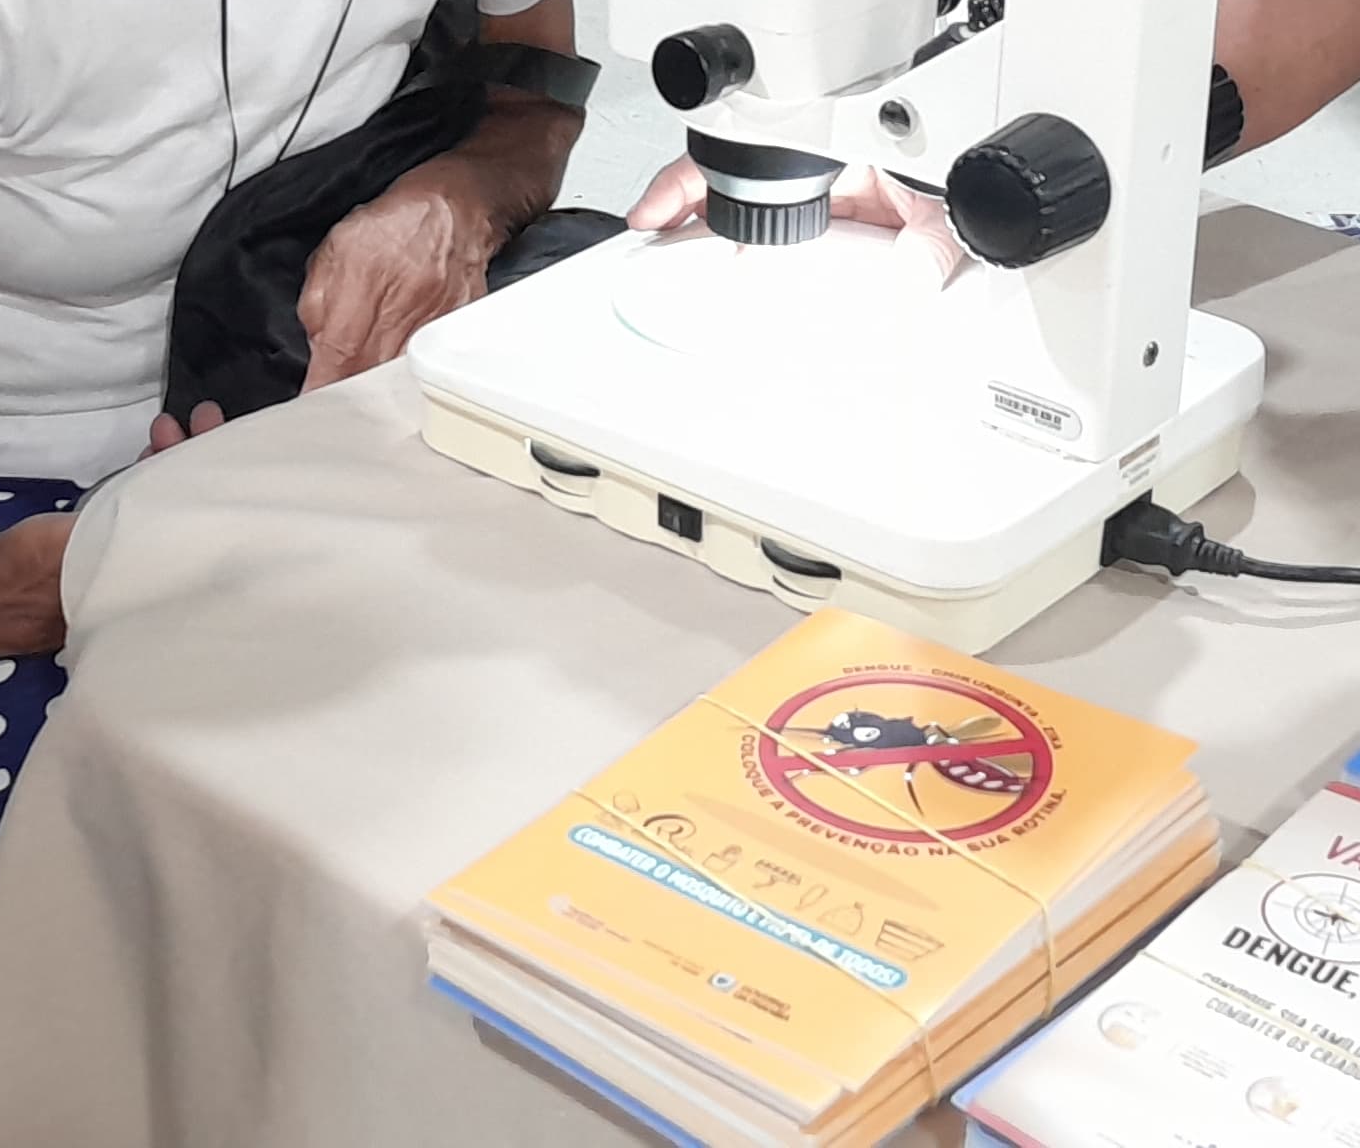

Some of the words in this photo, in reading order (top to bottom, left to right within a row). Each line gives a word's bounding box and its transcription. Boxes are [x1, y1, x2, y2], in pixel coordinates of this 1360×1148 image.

[843, 664, 913, 674] DENGUE
[741, 734, 775, 798] COLOQUE
[784, 810, 920, 857] PREVENÇÃO
[967, 834, 1010, 852] SUA
[1221, 926, 1360, 1000] DENGUE,
[1205, 996, 1287, 1042] COMBATER
[1286, 1035, 1307, 1053] OS
